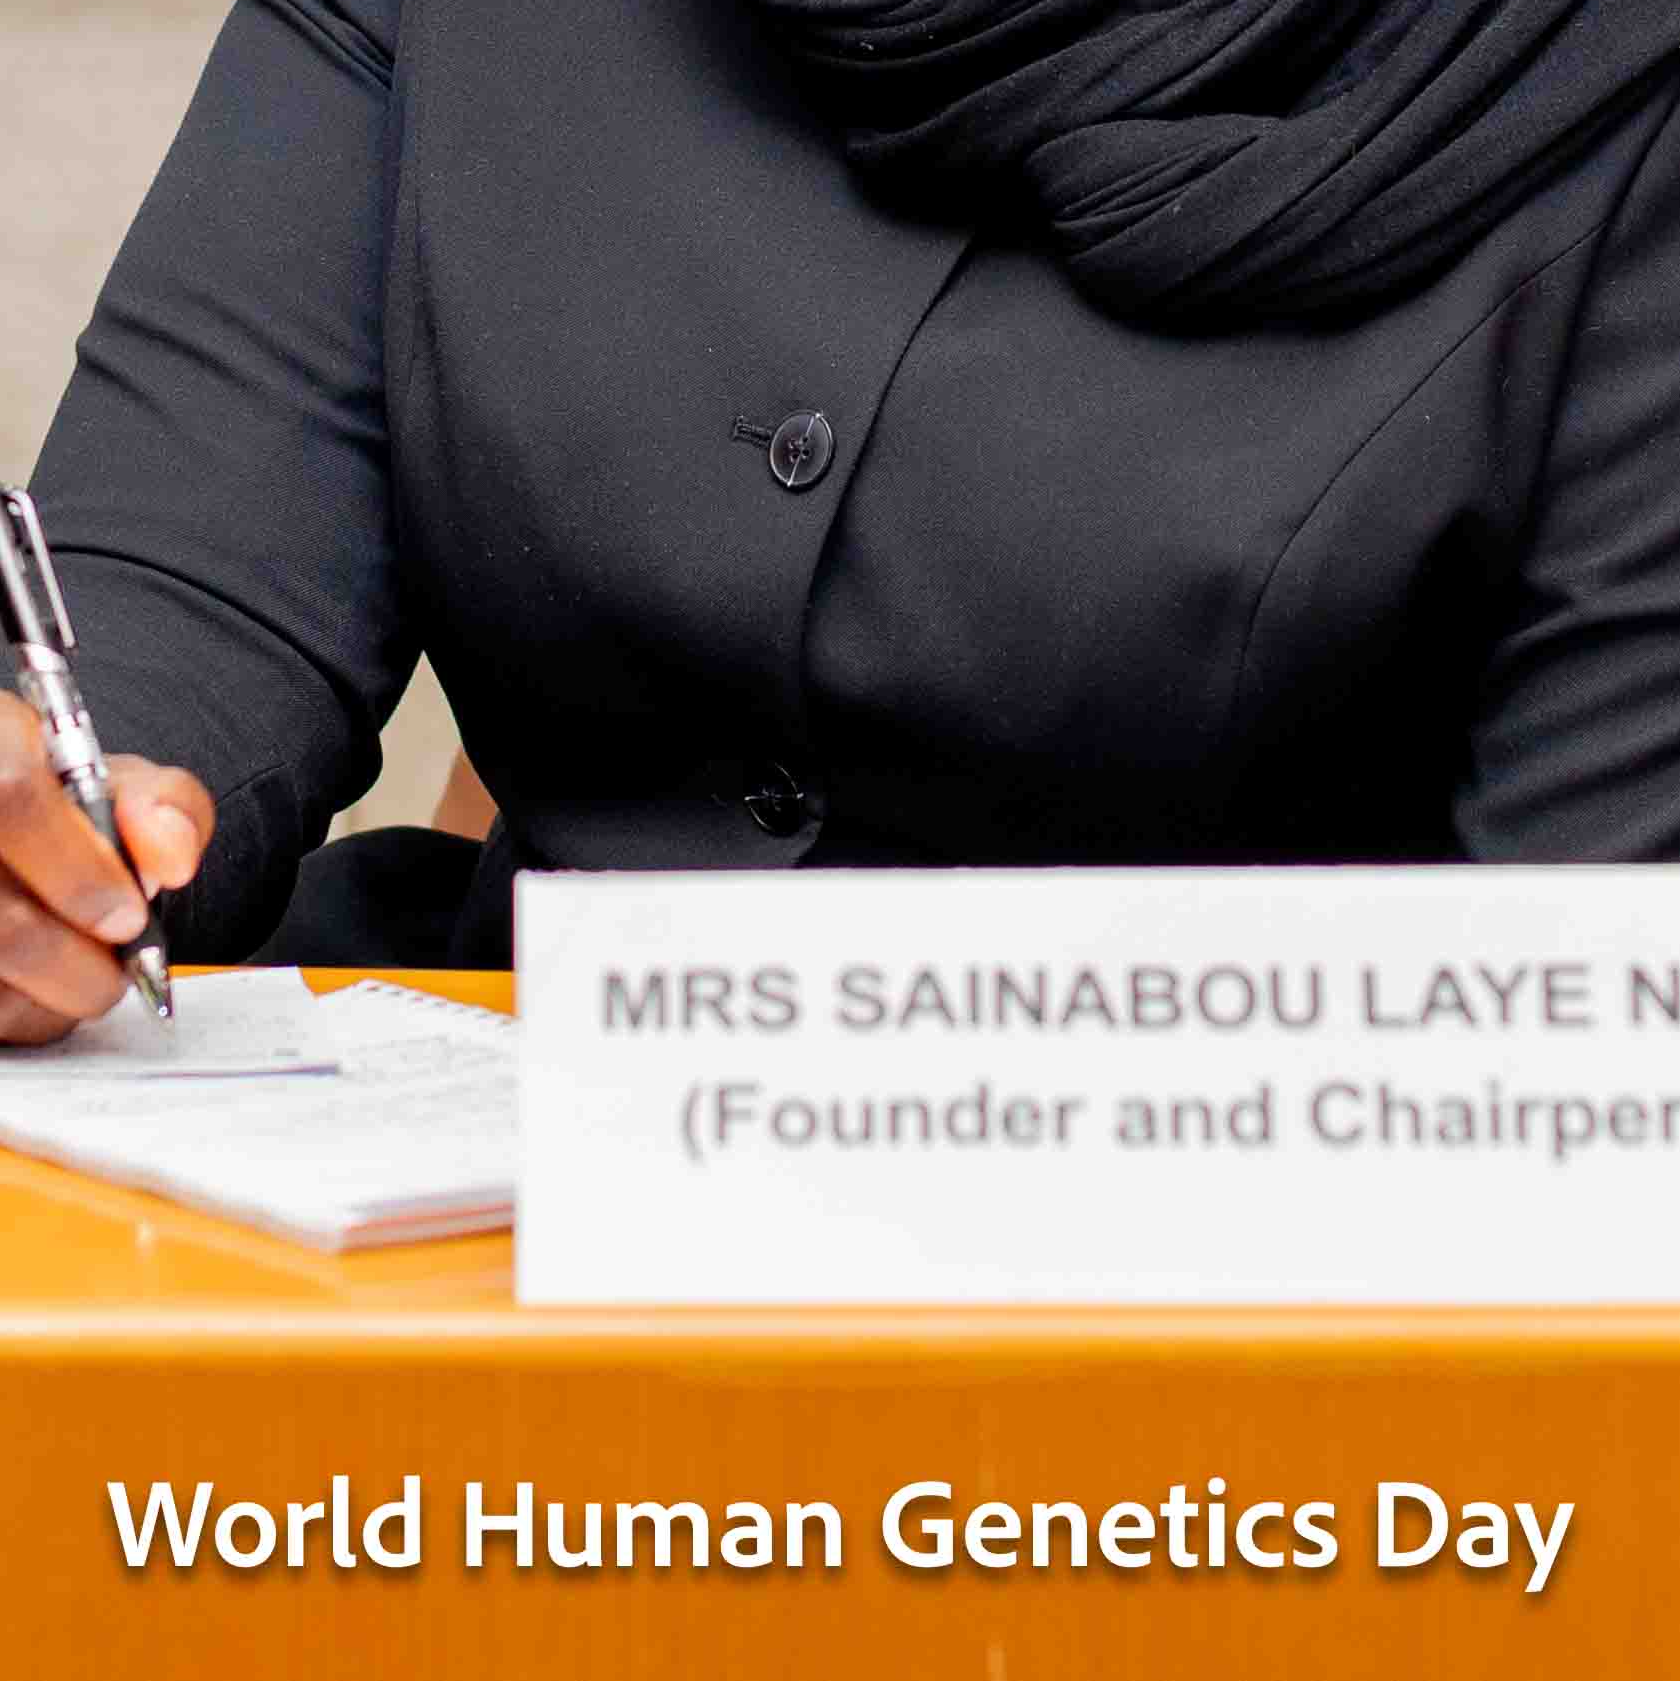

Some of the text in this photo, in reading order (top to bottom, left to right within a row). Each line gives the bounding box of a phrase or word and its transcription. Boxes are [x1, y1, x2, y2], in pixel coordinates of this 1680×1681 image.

[600, 964, 803, 1034] MRS
[835, 962, 1326, 1033] SAINABOU
[1358, 960, 1593, 1032] LAYE
[678, 1079, 1084, 1160] (Founder
[1112, 1080, 1277, 1149] and
